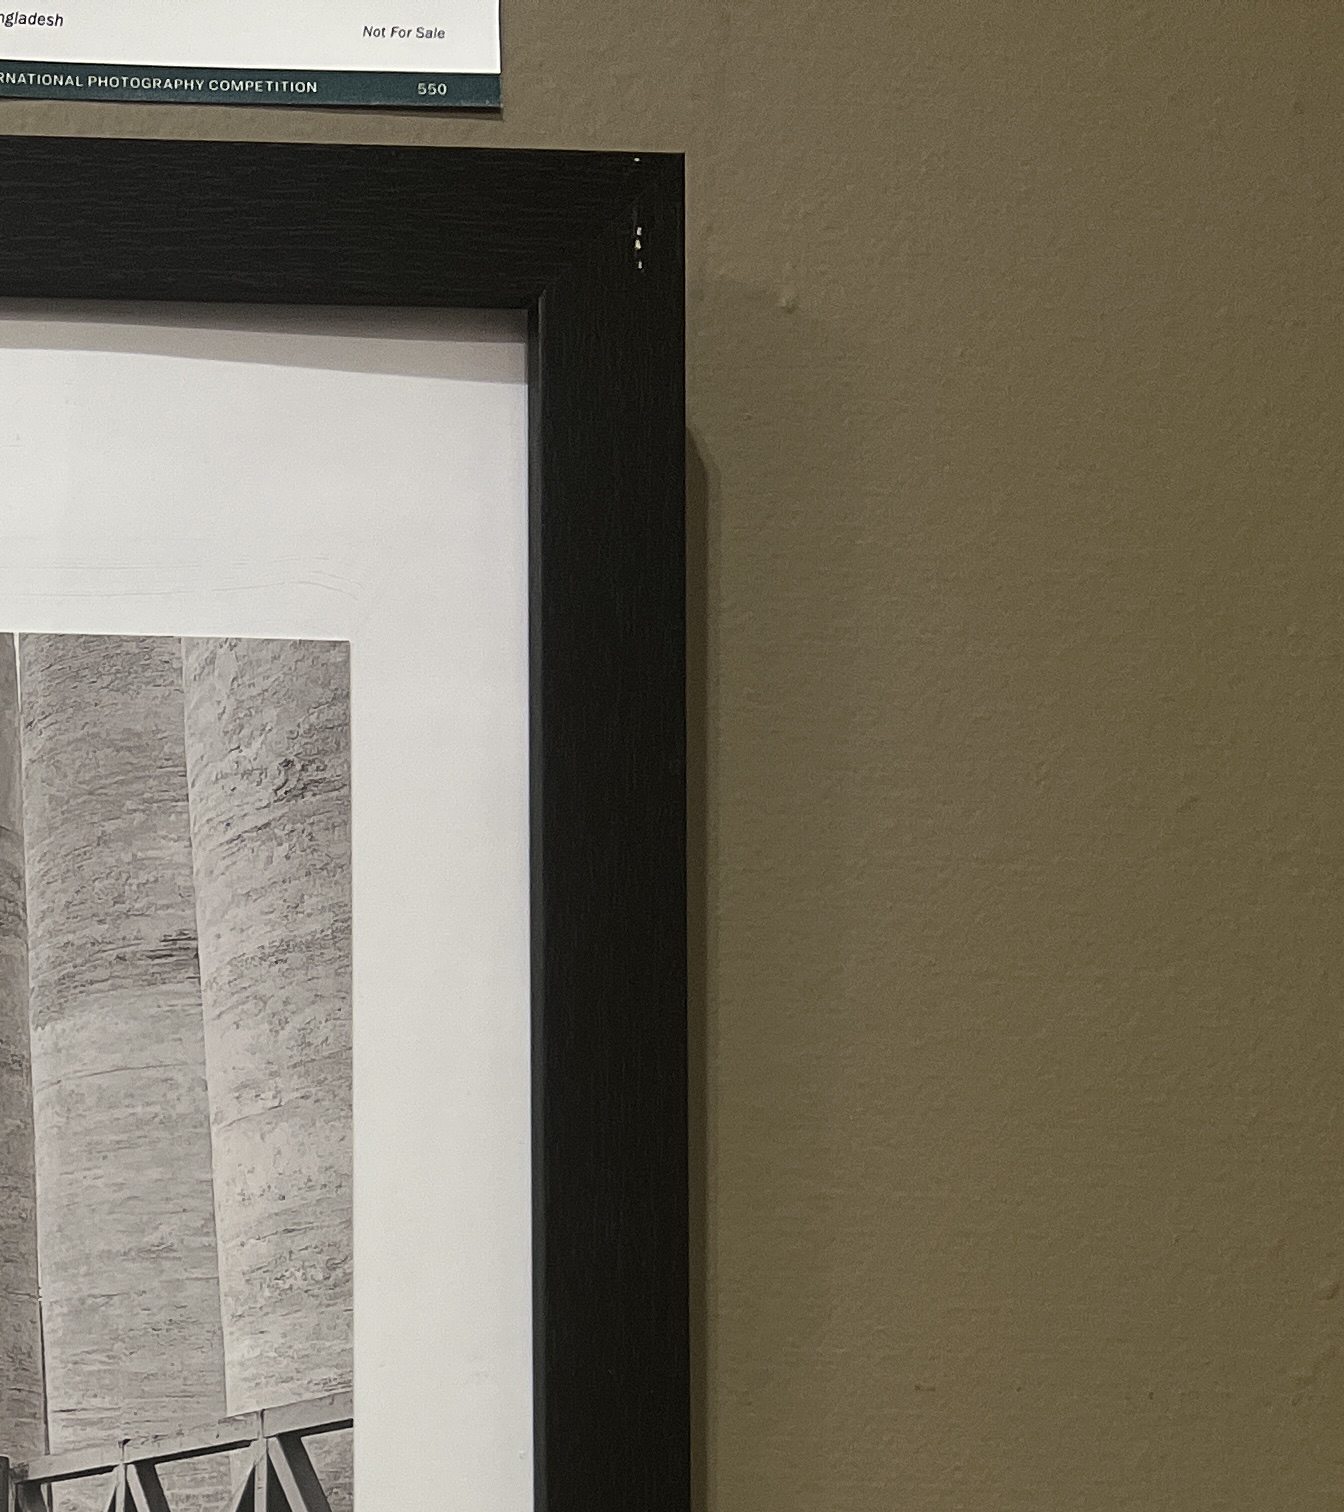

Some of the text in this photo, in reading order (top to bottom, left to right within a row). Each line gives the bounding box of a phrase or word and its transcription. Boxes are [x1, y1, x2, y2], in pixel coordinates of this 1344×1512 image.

[362, 26, 446, 39] Not For Sale
[87, 75, 205, 91] PHOTOGRAPHY
[208, 79, 317, 93] COMPETITION
[417, 82, 447, 96] 550
